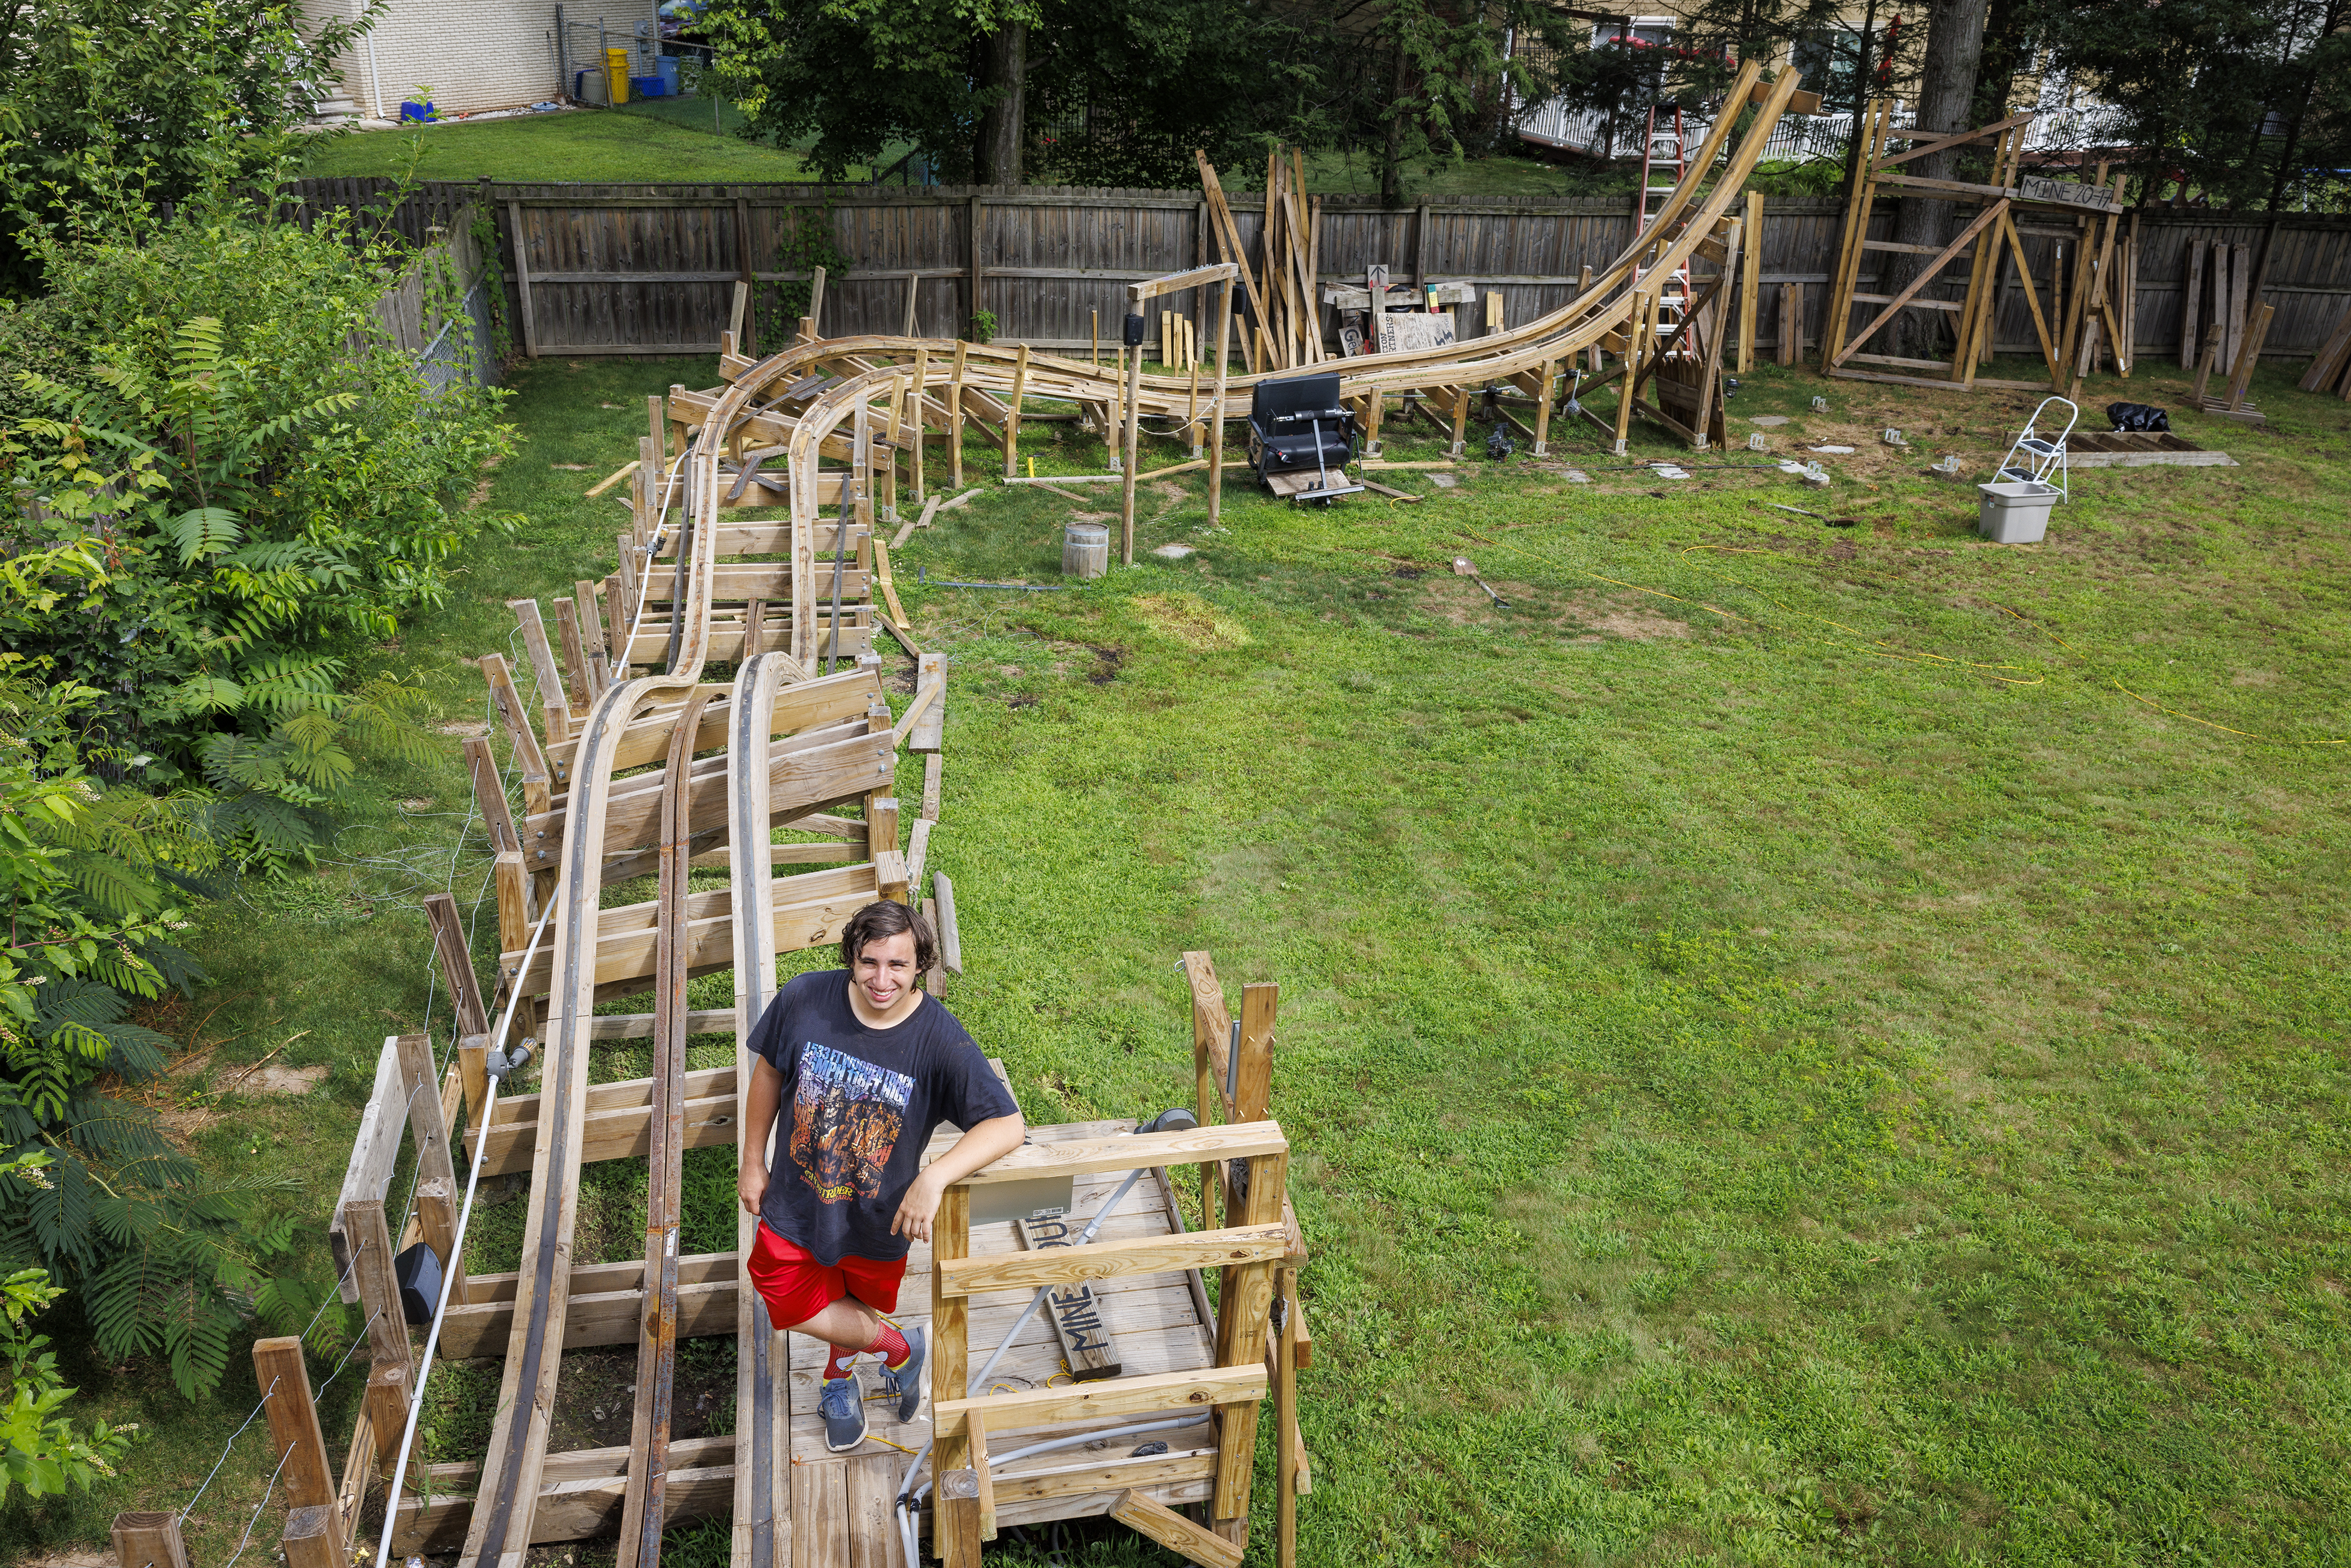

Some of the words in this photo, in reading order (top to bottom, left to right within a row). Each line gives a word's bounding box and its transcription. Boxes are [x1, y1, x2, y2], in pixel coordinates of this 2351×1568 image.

[2022, 179, 2074, 202] MINE
[2073, 184, 2113, 209] 20-17
[829, 1049, 843, 1063] FT
[842, 1053, 886, 1082] WOODEN
[883, 1069, 916, 1089] TRACK
[879, 1081, 913, 1106] HIGH
[1051, 1285, 1109, 1352] MINE
